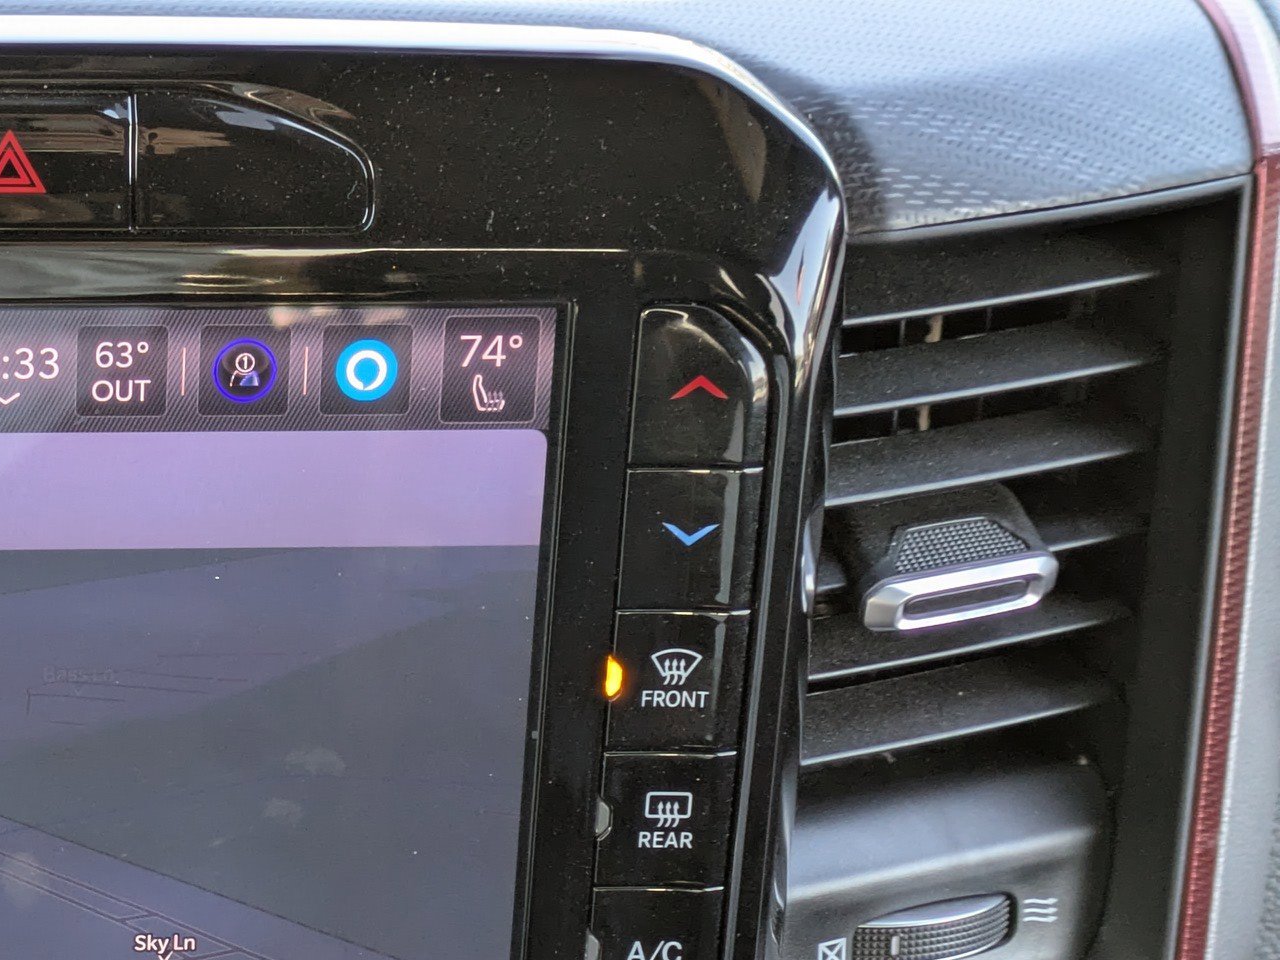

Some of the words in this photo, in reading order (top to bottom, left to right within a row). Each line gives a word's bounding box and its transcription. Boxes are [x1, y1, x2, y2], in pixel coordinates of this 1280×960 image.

[95, 341, 149, 369] 63°
[460, 334, 523, 368] 74°
[91, 379, 152, 402] OUT
[641, 690, 710, 708] FRONT
[638, 831, 693, 849] REAR
[134, 934, 169, 954] Sky
[173, 934, 196, 951] Ln
